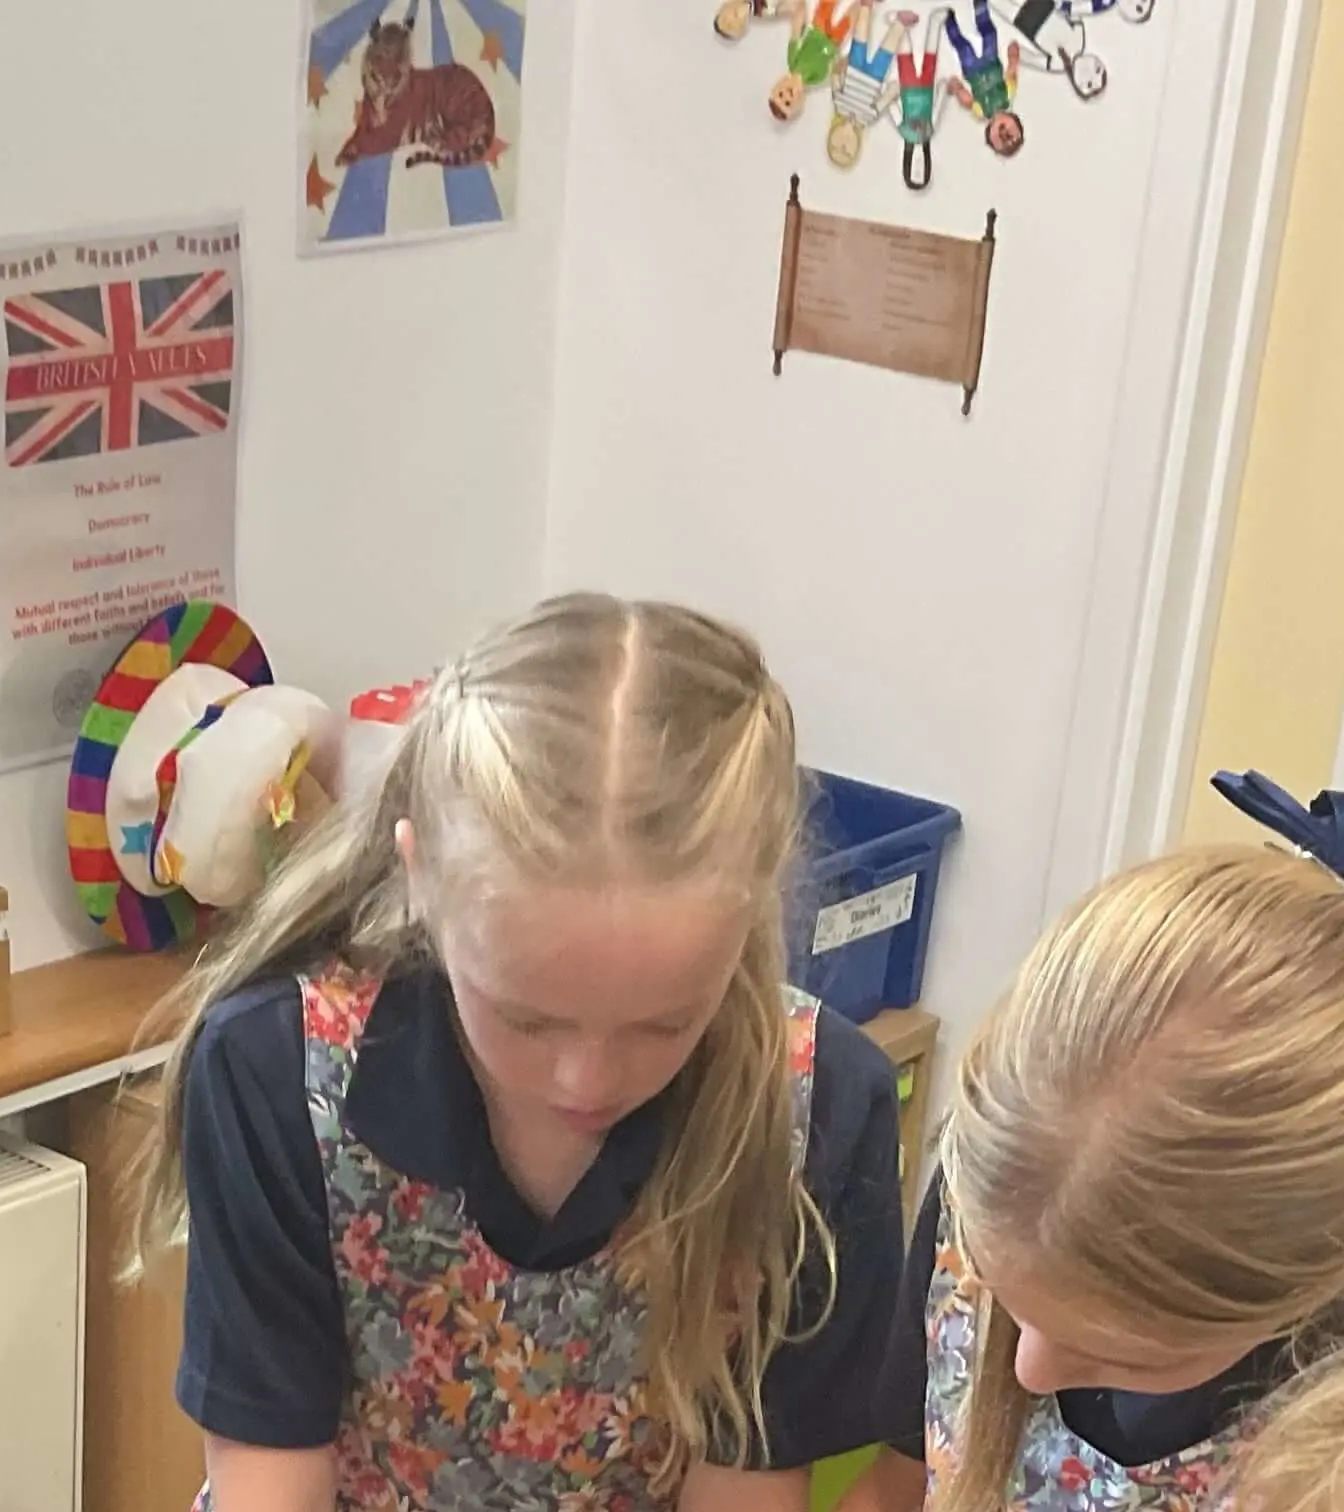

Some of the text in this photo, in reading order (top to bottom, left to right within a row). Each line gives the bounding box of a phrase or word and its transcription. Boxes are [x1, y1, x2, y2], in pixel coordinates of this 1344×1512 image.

[73, 483, 94, 498] The
[97, 478, 121, 493] Rule
[124, 475, 136, 489] of
[88, 512, 150, 534] Democracy
[72, 544, 166, 572] Individual Liberty
[15, 600, 55, 620] Mutual
[58, 591, 100, 611] respect
[103, 586, 124, 601] and
[12, 623, 38, 640] with
[41, 609, 91, 633] different
